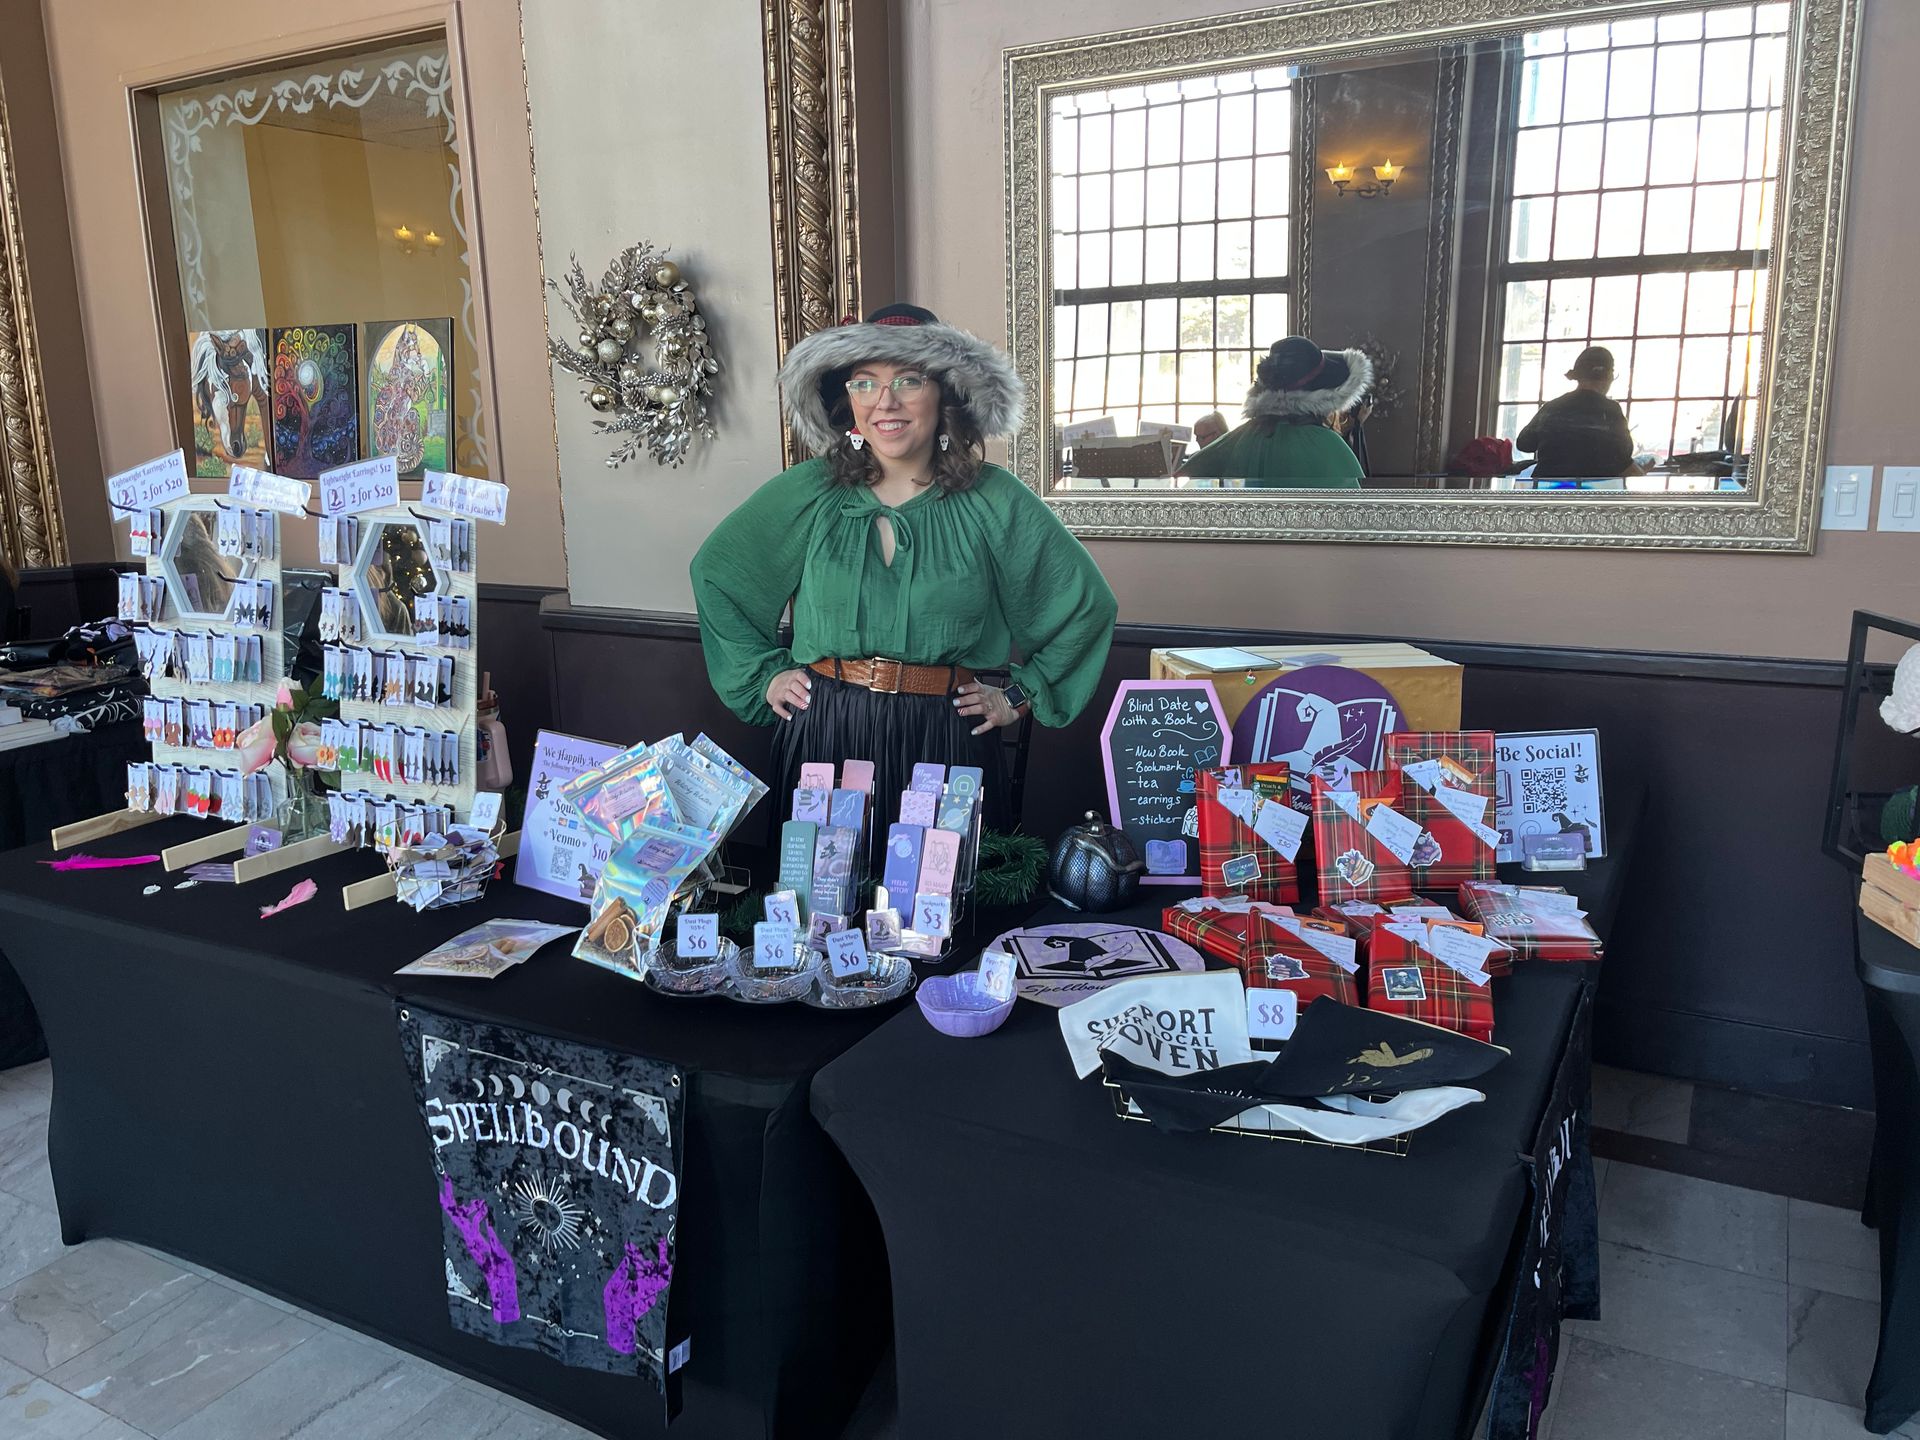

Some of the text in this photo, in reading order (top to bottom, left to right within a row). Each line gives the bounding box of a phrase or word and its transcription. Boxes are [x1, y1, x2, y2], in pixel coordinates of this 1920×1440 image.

[142, 461, 167, 476] Earrings!
[168, 458, 179, 469] $12
[352, 465, 378, 479] Earrings!
[380, 463, 391, 473] $12
[143, 478, 183, 502] 2 for $20
[351, 484, 393, 507] 2 for $20
[1127, 696, 1191, 713] Blind Date
[1122, 712, 1198, 726] with a Book
[544, 746, 605, 769] We Happily Acc
[1158, 744, 1189, 758] Book
[1495, 742, 1582, 762] Be Social!
[475, 802, 492, 818] $8
[555, 798, 577, 816] Squa
[550, 828, 580, 848] Venmo
[592, 843, 608, 862] $10
[773, 907, 791, 922] $3
[923, 907, 942, 930] $3
[688, 935, 707, 952] $6
[764, 944, 783, 960] $6
[840, 951, 859, 971] $6
[1087, 1003, 1216, 1040] SUPPORT
[1257, 1001, 1284, 1028] $8
[425, 1097, 677, 1210] SPELLBOUND
